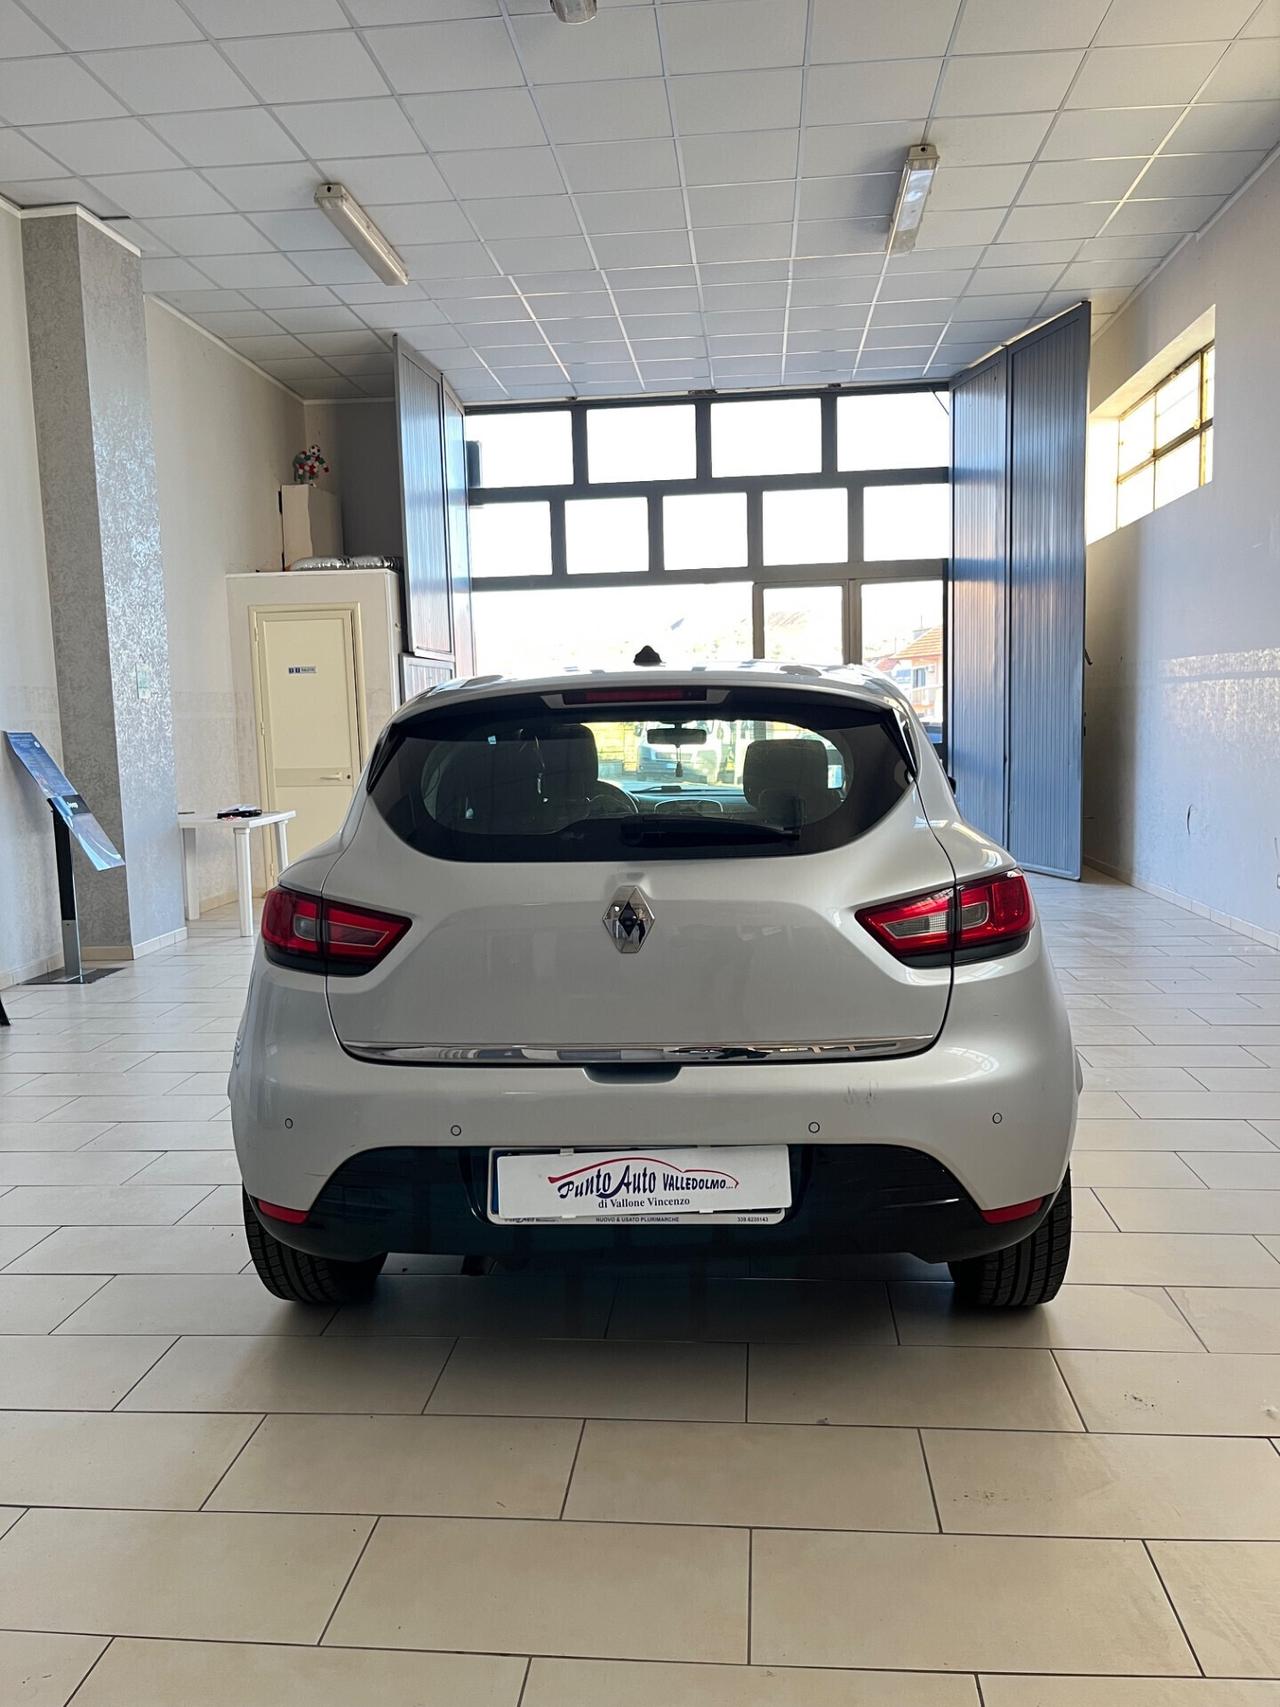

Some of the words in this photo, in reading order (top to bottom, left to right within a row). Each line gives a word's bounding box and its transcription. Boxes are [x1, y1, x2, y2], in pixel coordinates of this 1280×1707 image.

[557, 1168, 611, 1199] Punto
[596, 1164, 657, 1199] Auto
[598, 1199, 608, 1209] di
[610, 1198, 645, 1208] Vallone
[647, 1197, 690, 1207] Vincenzo
